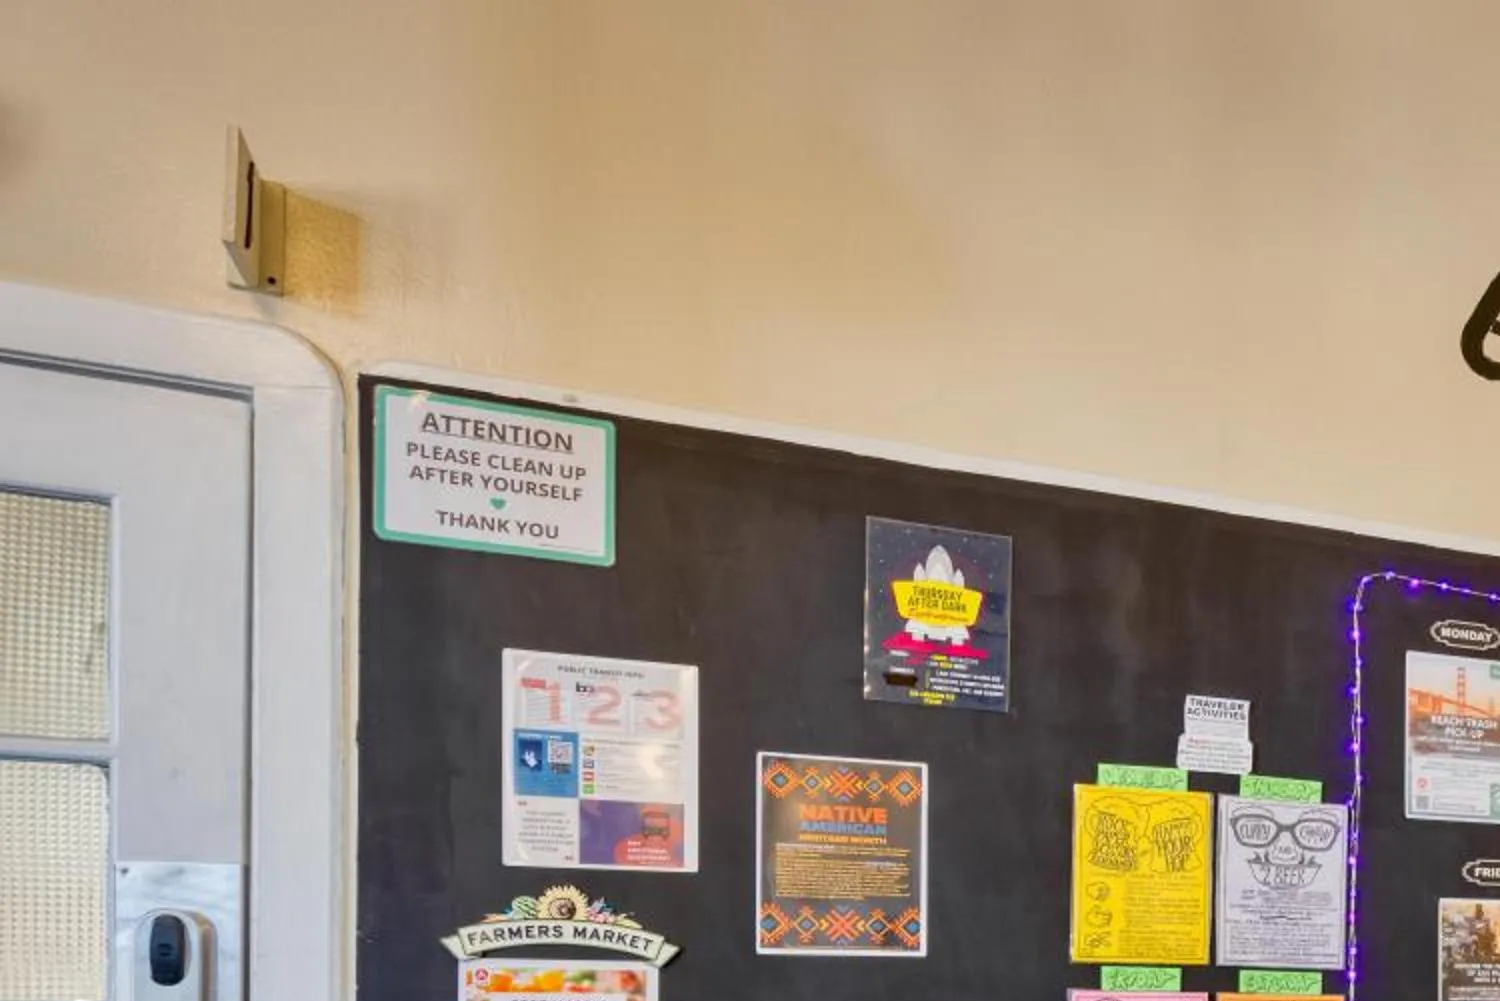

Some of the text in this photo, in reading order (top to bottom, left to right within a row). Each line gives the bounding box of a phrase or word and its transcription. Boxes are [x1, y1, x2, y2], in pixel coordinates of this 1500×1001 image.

[421, 412, 573, 451] ATTENTION
[407, 442, 586, 481] PLEASE CLEAN UP
[410, 465, 583, 502] AFTER YOURSELF
[436, 510, 559, 539] THANK YOU
[1440, 627, 1493, 643] MONDAY
[586, 685, 621, 725] 2
[645, 689, 682, 729] 3
[799, 821, 887, 834] AMERICAN
[800, 804, 888, 824] NATIVE
[467, 925, 654, 950] FARMERS MARKET
